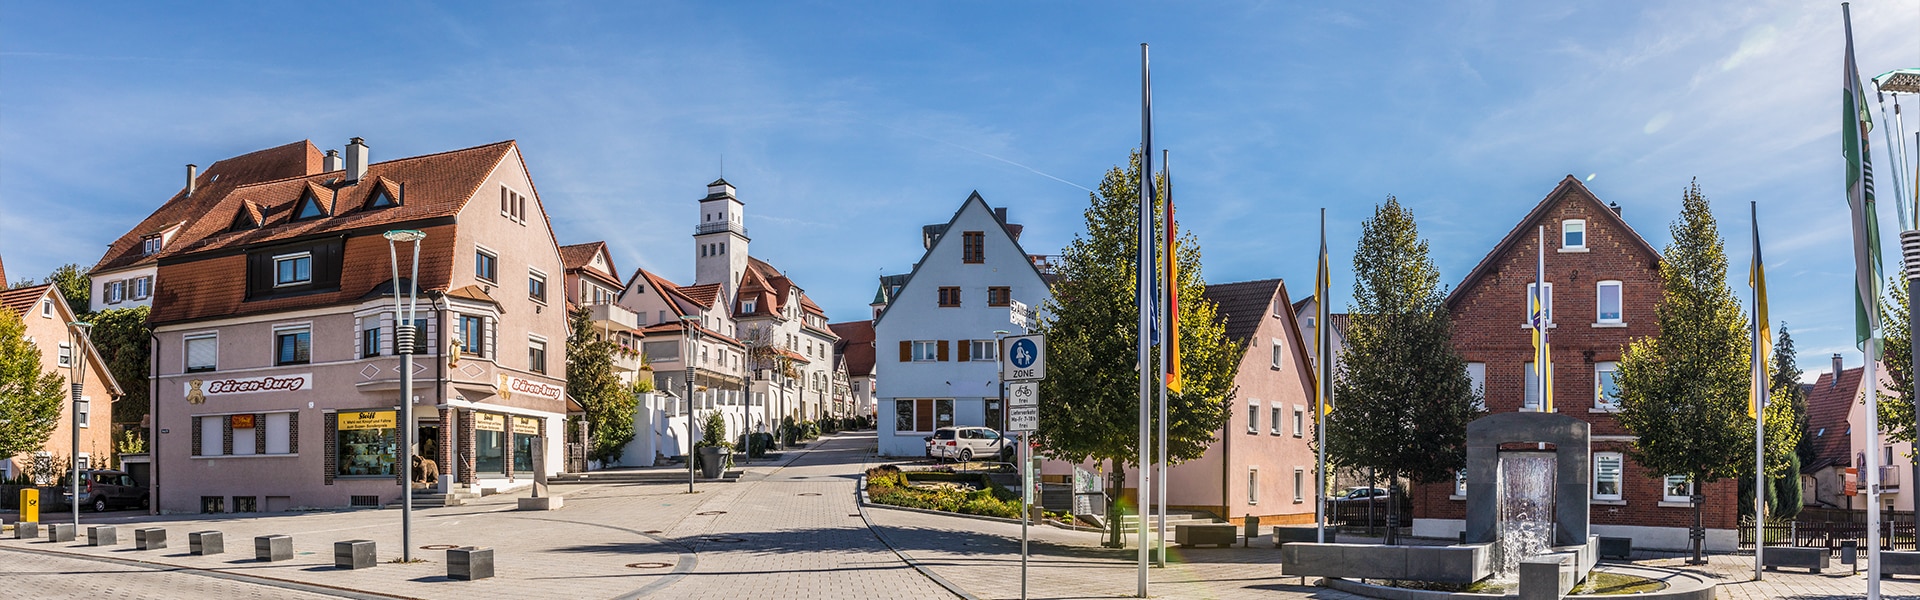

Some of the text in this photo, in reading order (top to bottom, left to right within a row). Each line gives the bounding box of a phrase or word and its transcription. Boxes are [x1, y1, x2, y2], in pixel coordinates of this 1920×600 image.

[1013, 369, 1034, 378] ZONE
[208, 377, 305, 394] Bären-Burg
[512, 379, 560, 399] Bären-Burg
